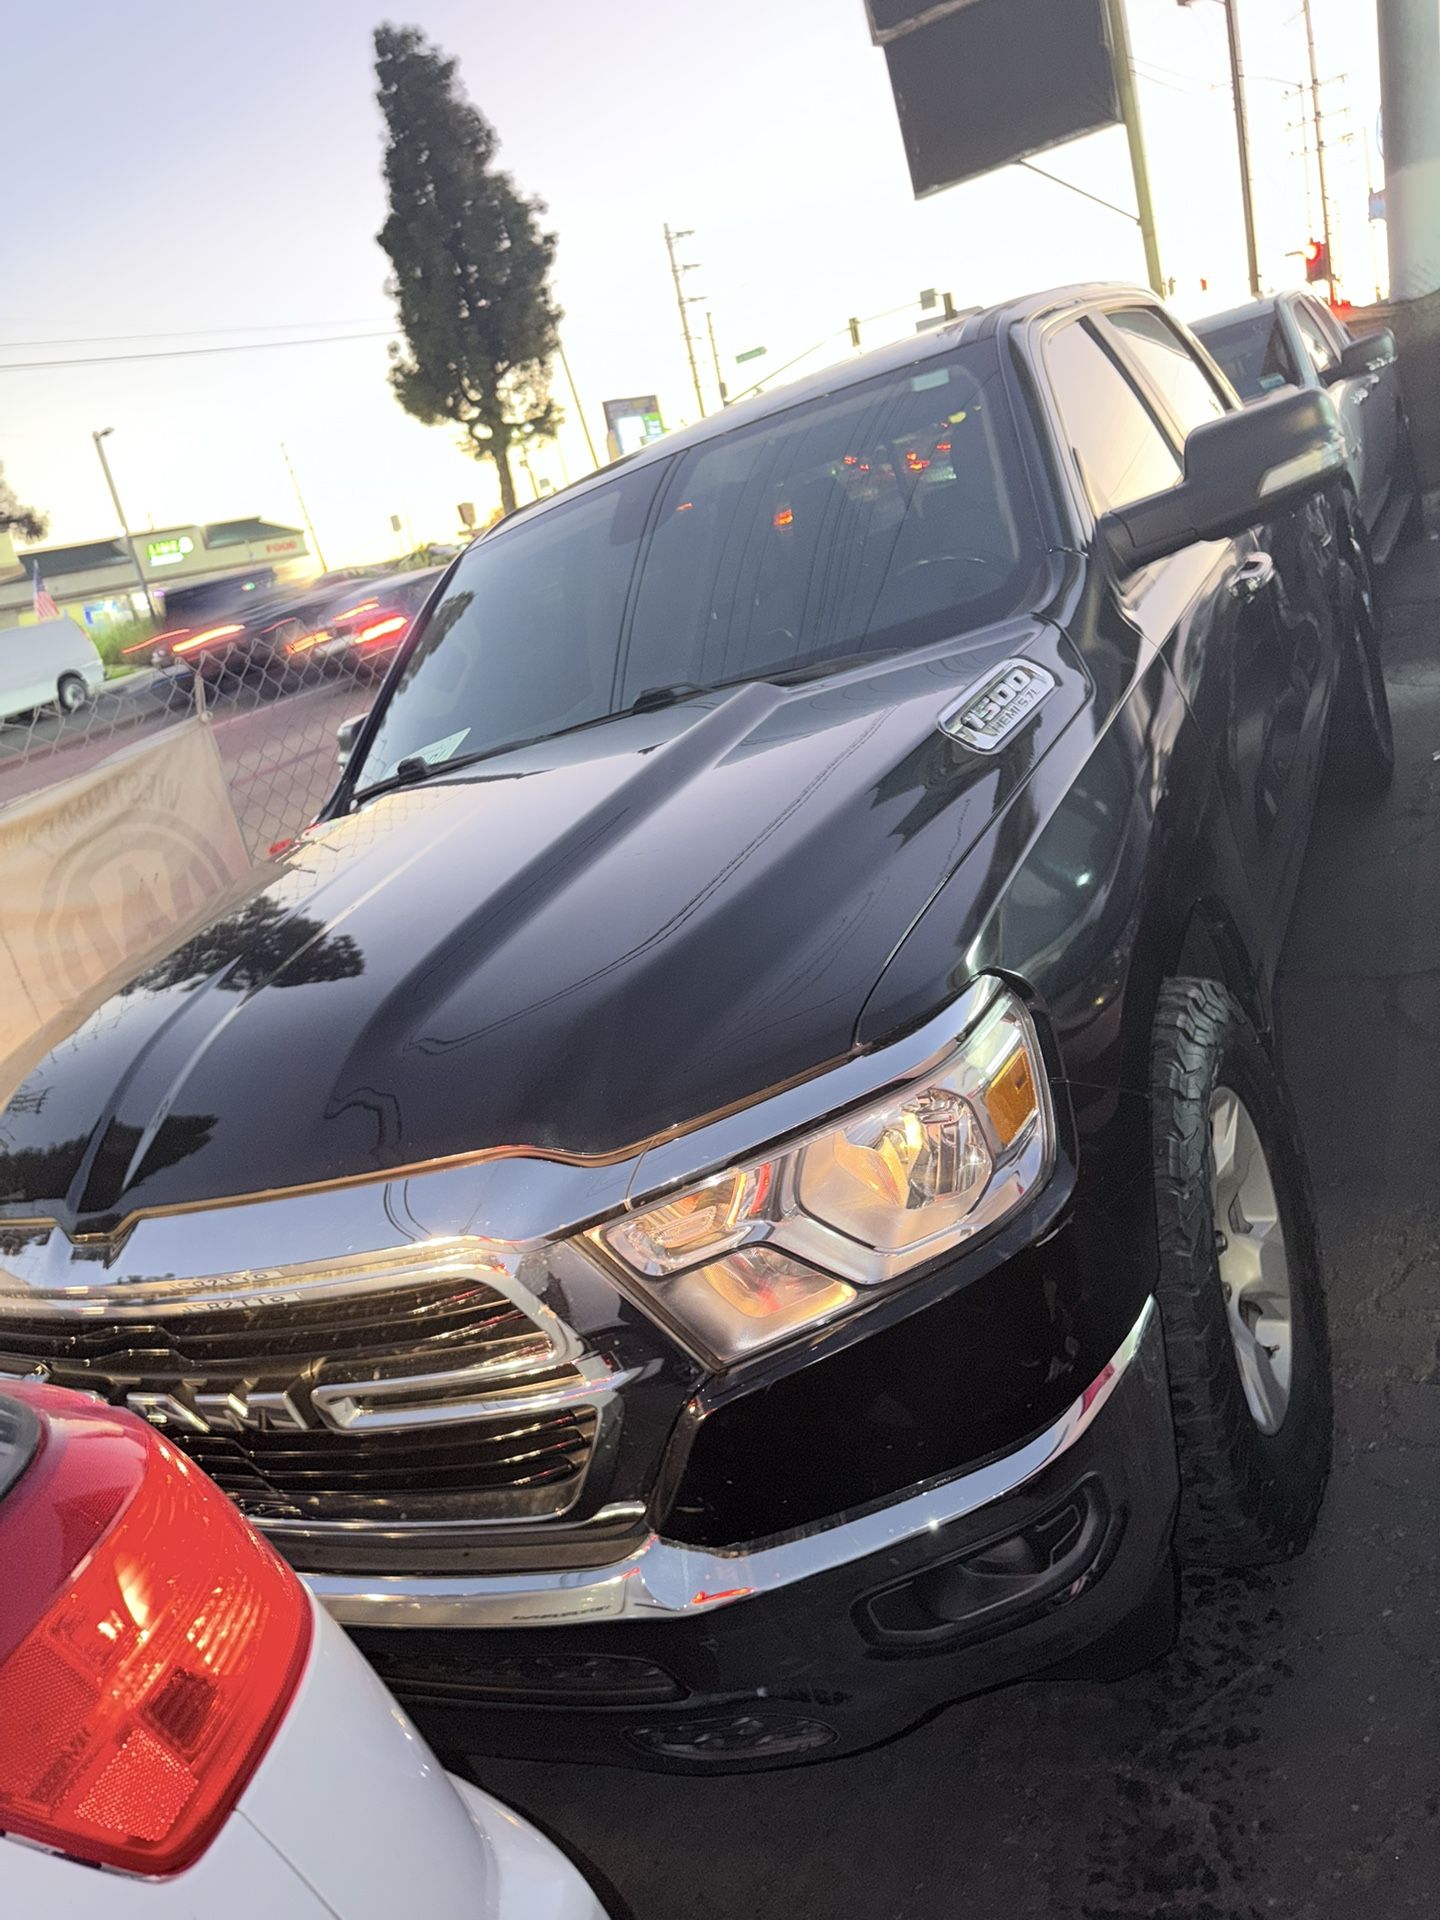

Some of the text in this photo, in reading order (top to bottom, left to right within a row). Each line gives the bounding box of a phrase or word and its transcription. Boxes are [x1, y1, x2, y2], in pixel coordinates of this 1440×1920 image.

[962, 667, 1032, 730] 1500
[992, 687, 1042, 734] HEMI 5.7L
